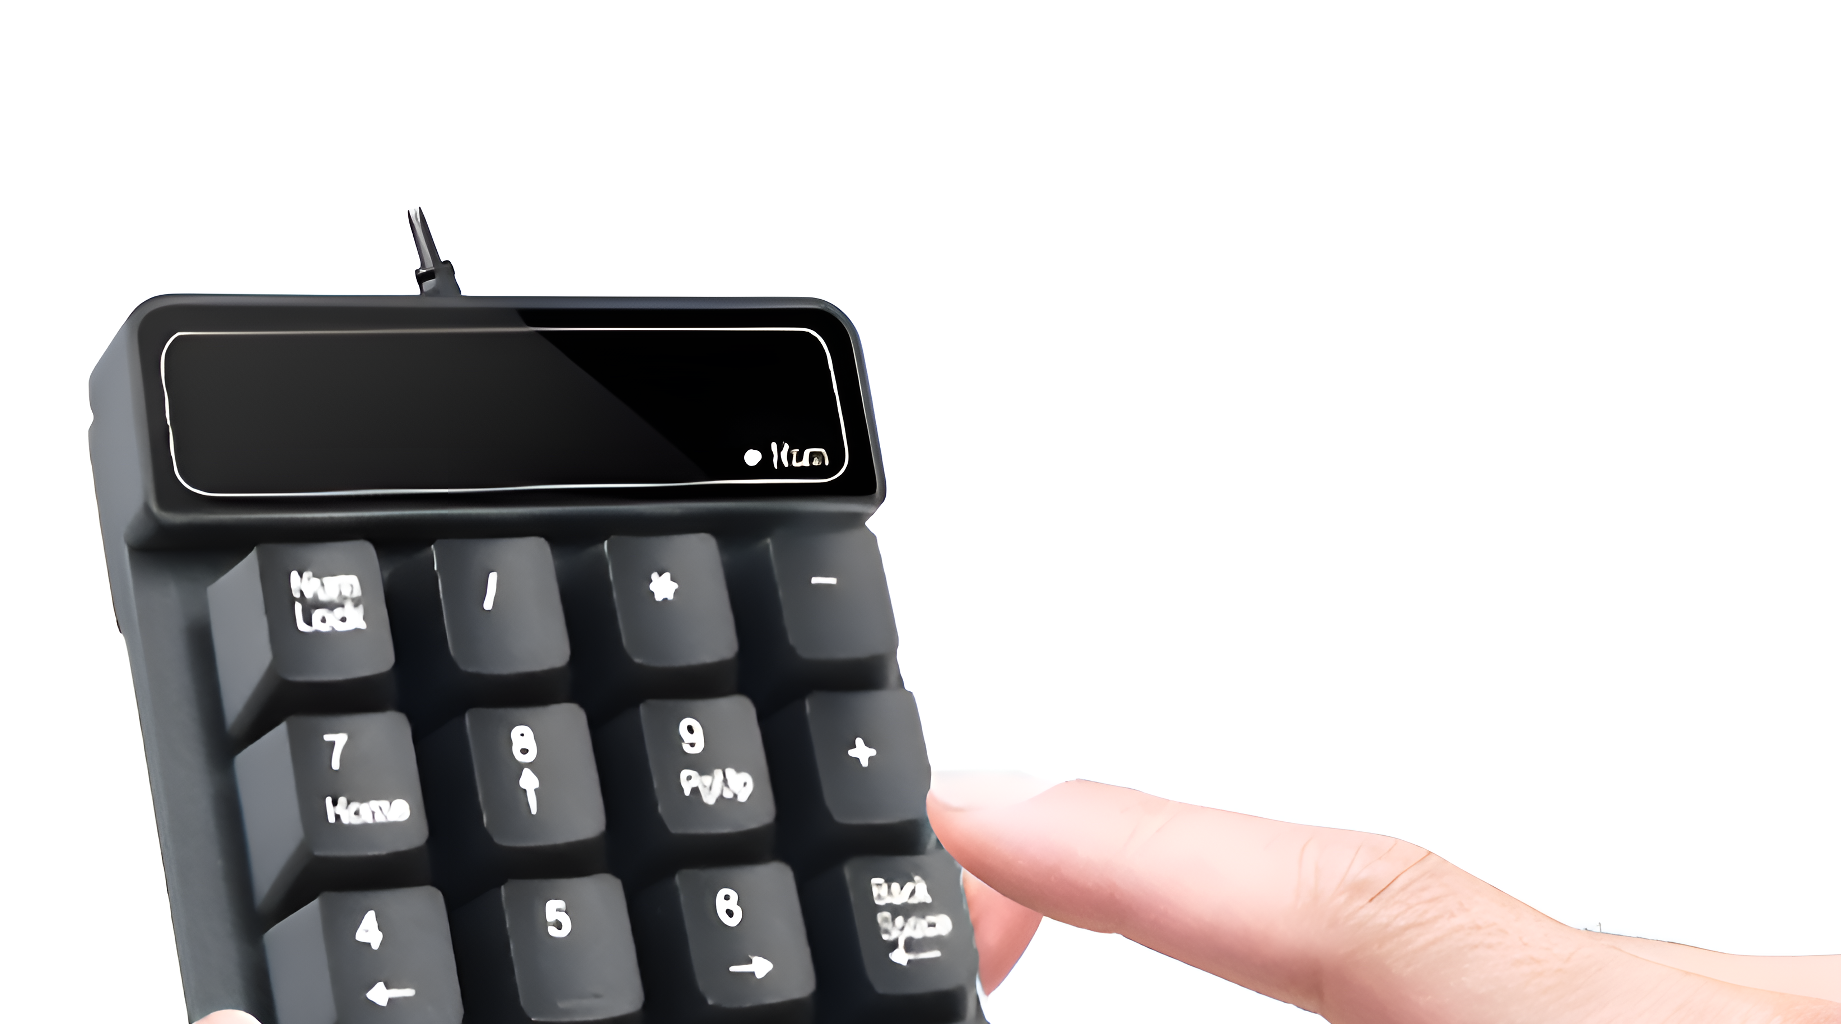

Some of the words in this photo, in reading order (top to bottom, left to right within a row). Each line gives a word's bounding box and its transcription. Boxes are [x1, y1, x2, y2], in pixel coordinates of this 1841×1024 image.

[322, 732, 349, 771] 7
[510, 724, 538, 764] 8
[678, 717, 705, 755] 9
[545, 899, 573, 939] 5
[715, 887, 743, 928] 6
[354, 909, 384, 951] 4
